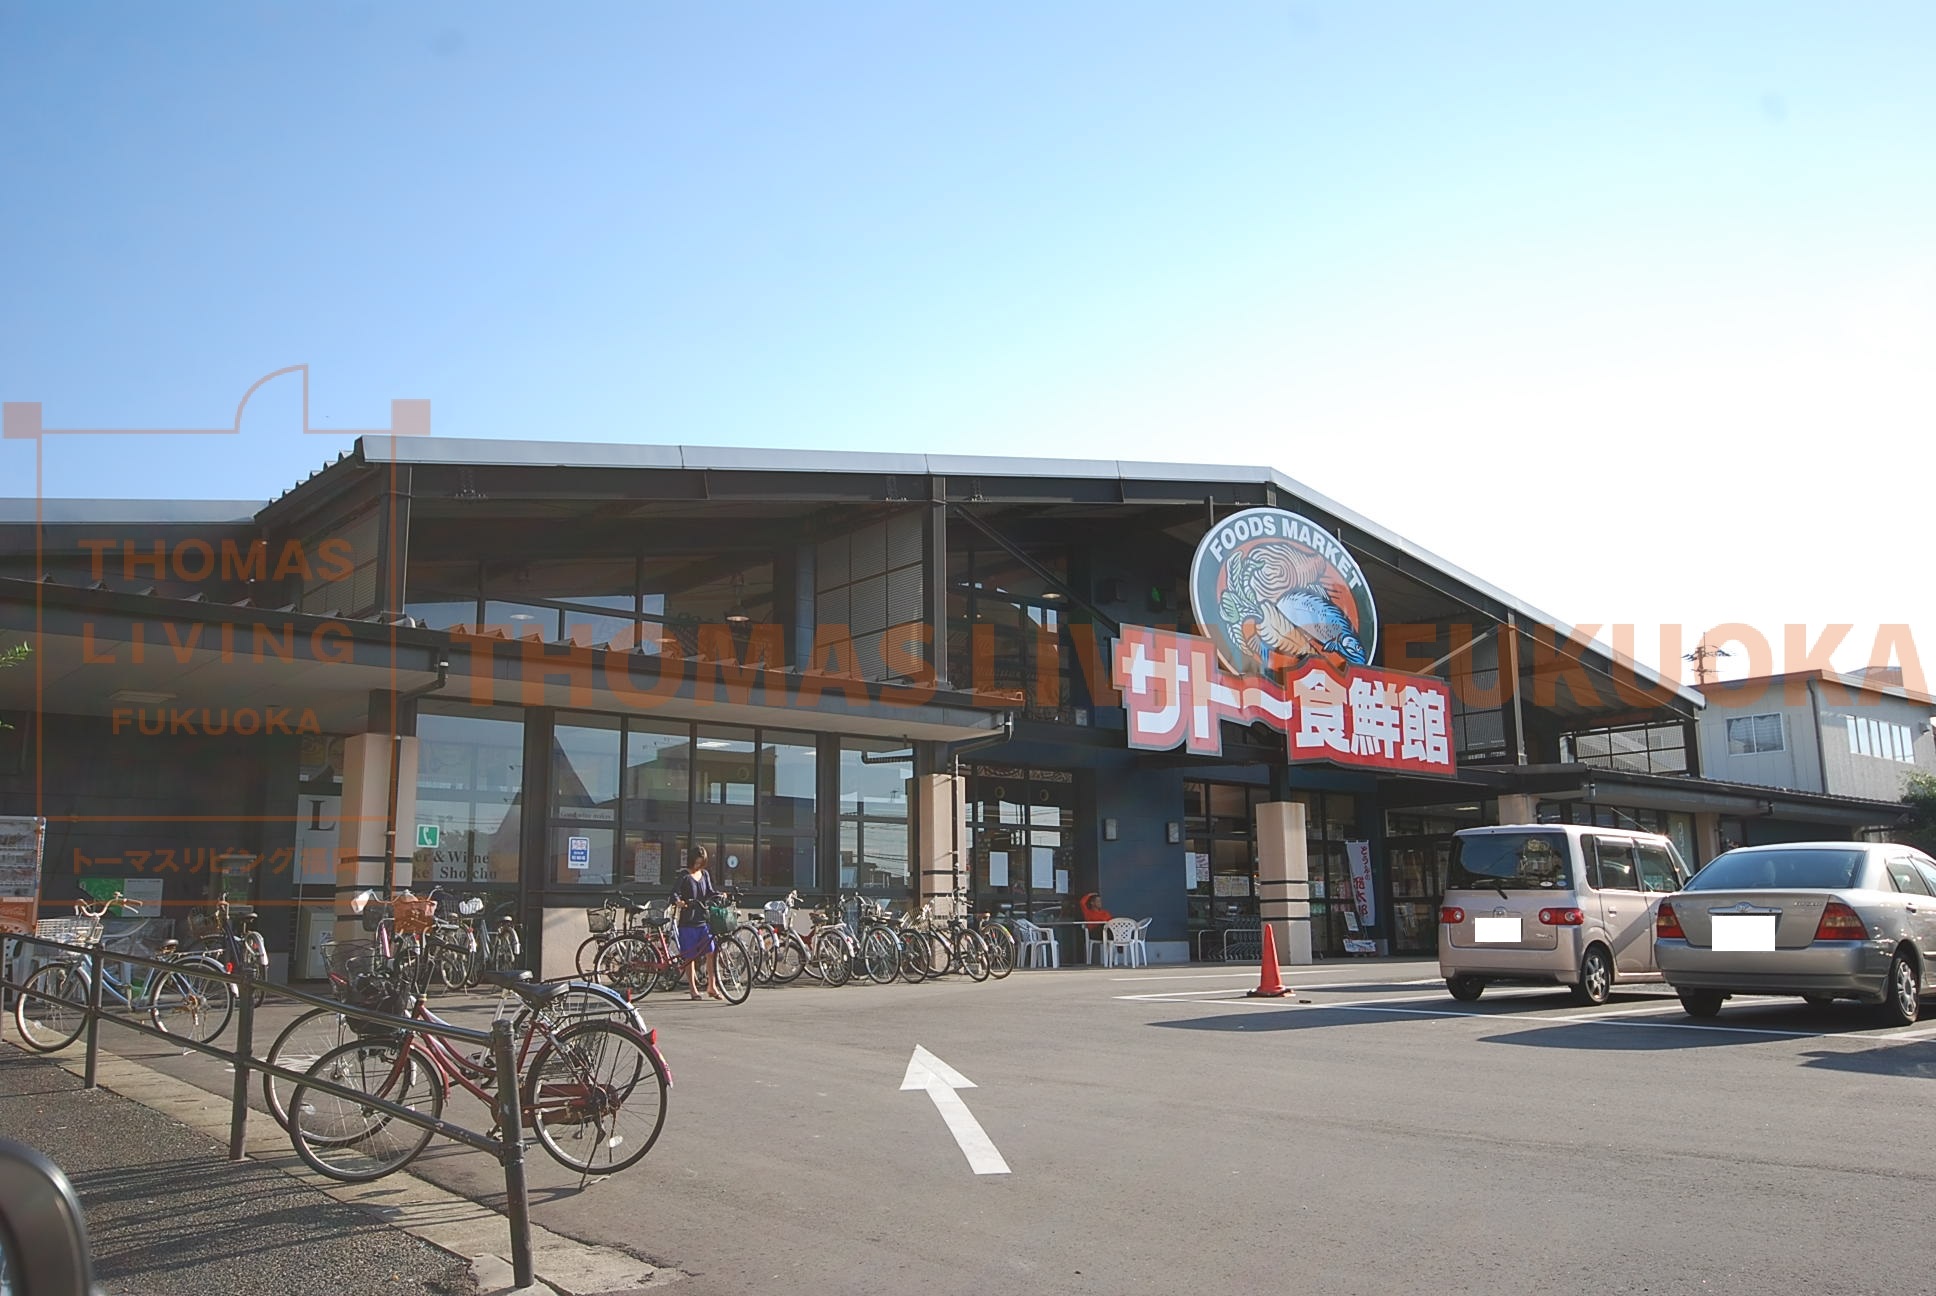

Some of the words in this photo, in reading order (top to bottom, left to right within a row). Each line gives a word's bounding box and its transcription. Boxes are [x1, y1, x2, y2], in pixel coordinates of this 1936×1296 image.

[1209, 515, 1277, 563] FOODS
[1282, 519, 1363, 590] MARKET
[433, 851, 444, 863] &
[448, 851, 489, 864] Wine
[440, 867, 497, 880] Shochu
